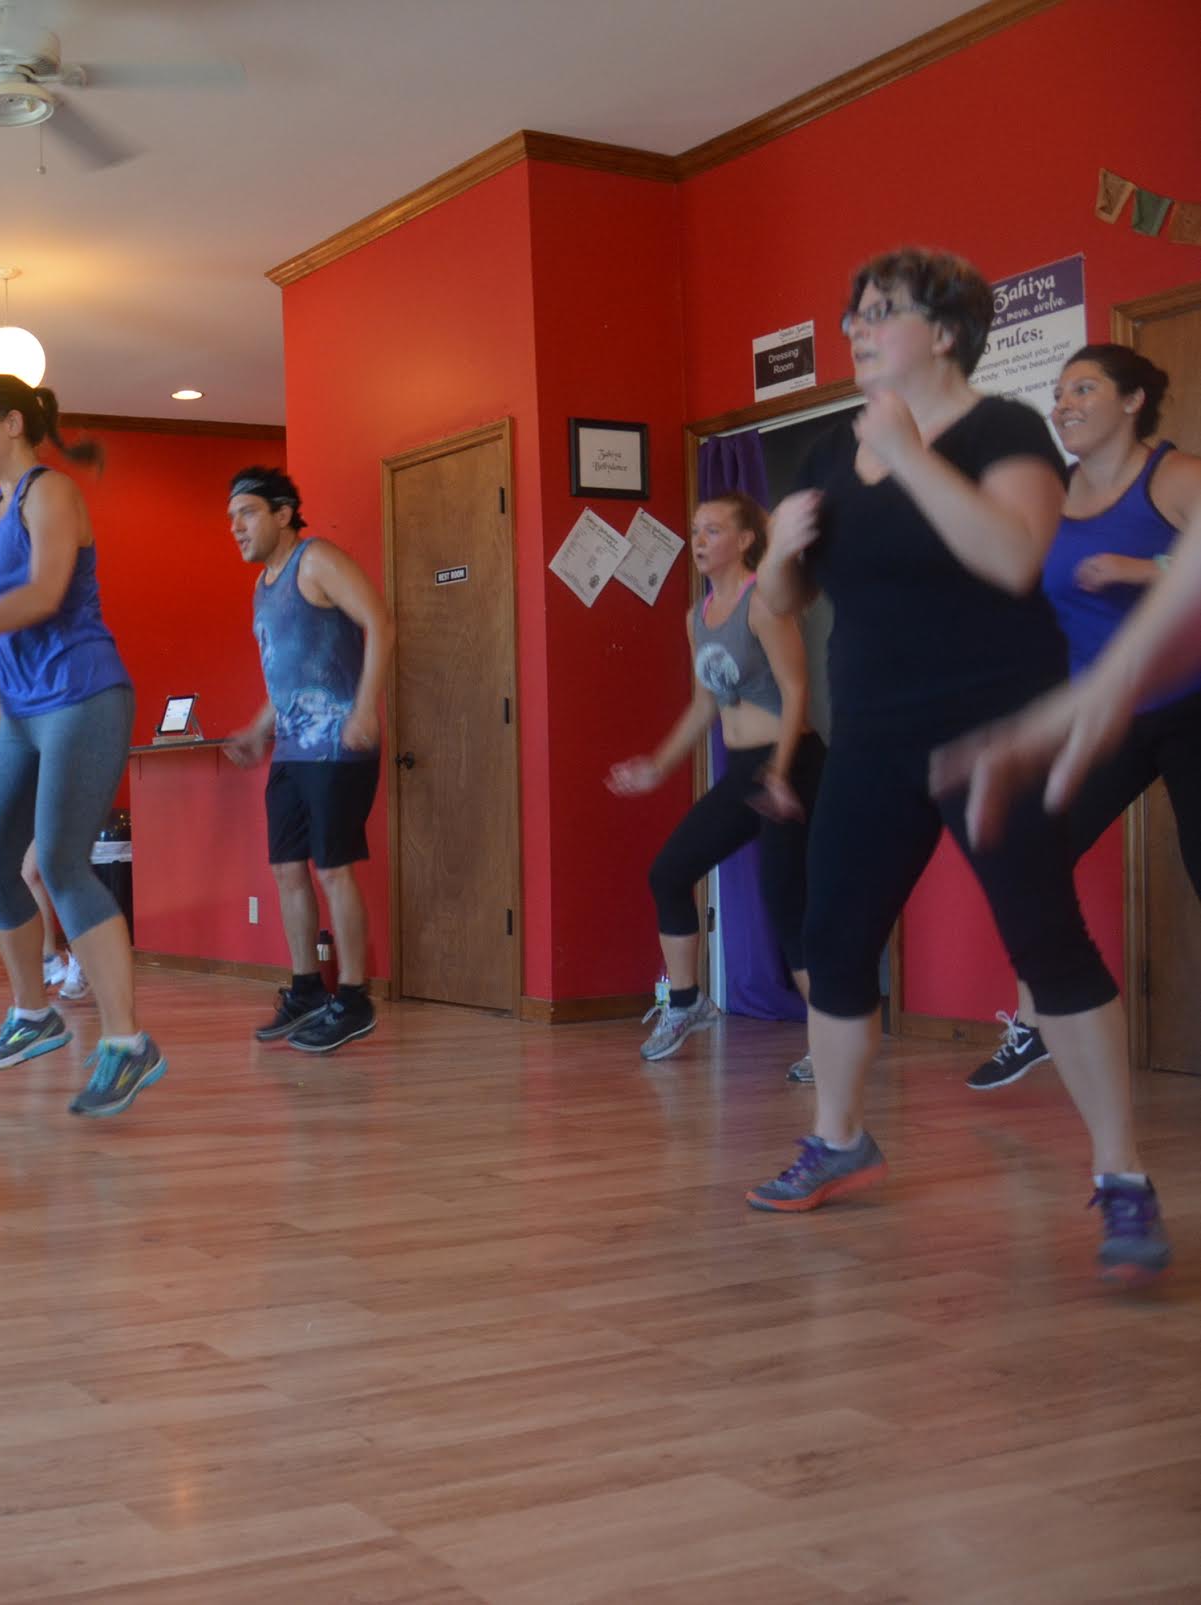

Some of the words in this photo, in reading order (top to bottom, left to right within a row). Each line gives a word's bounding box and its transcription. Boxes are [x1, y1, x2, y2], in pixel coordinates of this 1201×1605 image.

[991, 275, 1056, 313] Zahiya
[997, 327, 1044, 351] rules:
[768, 348, 799, 364] Dressing
[773, 362, 794, 375] Room
